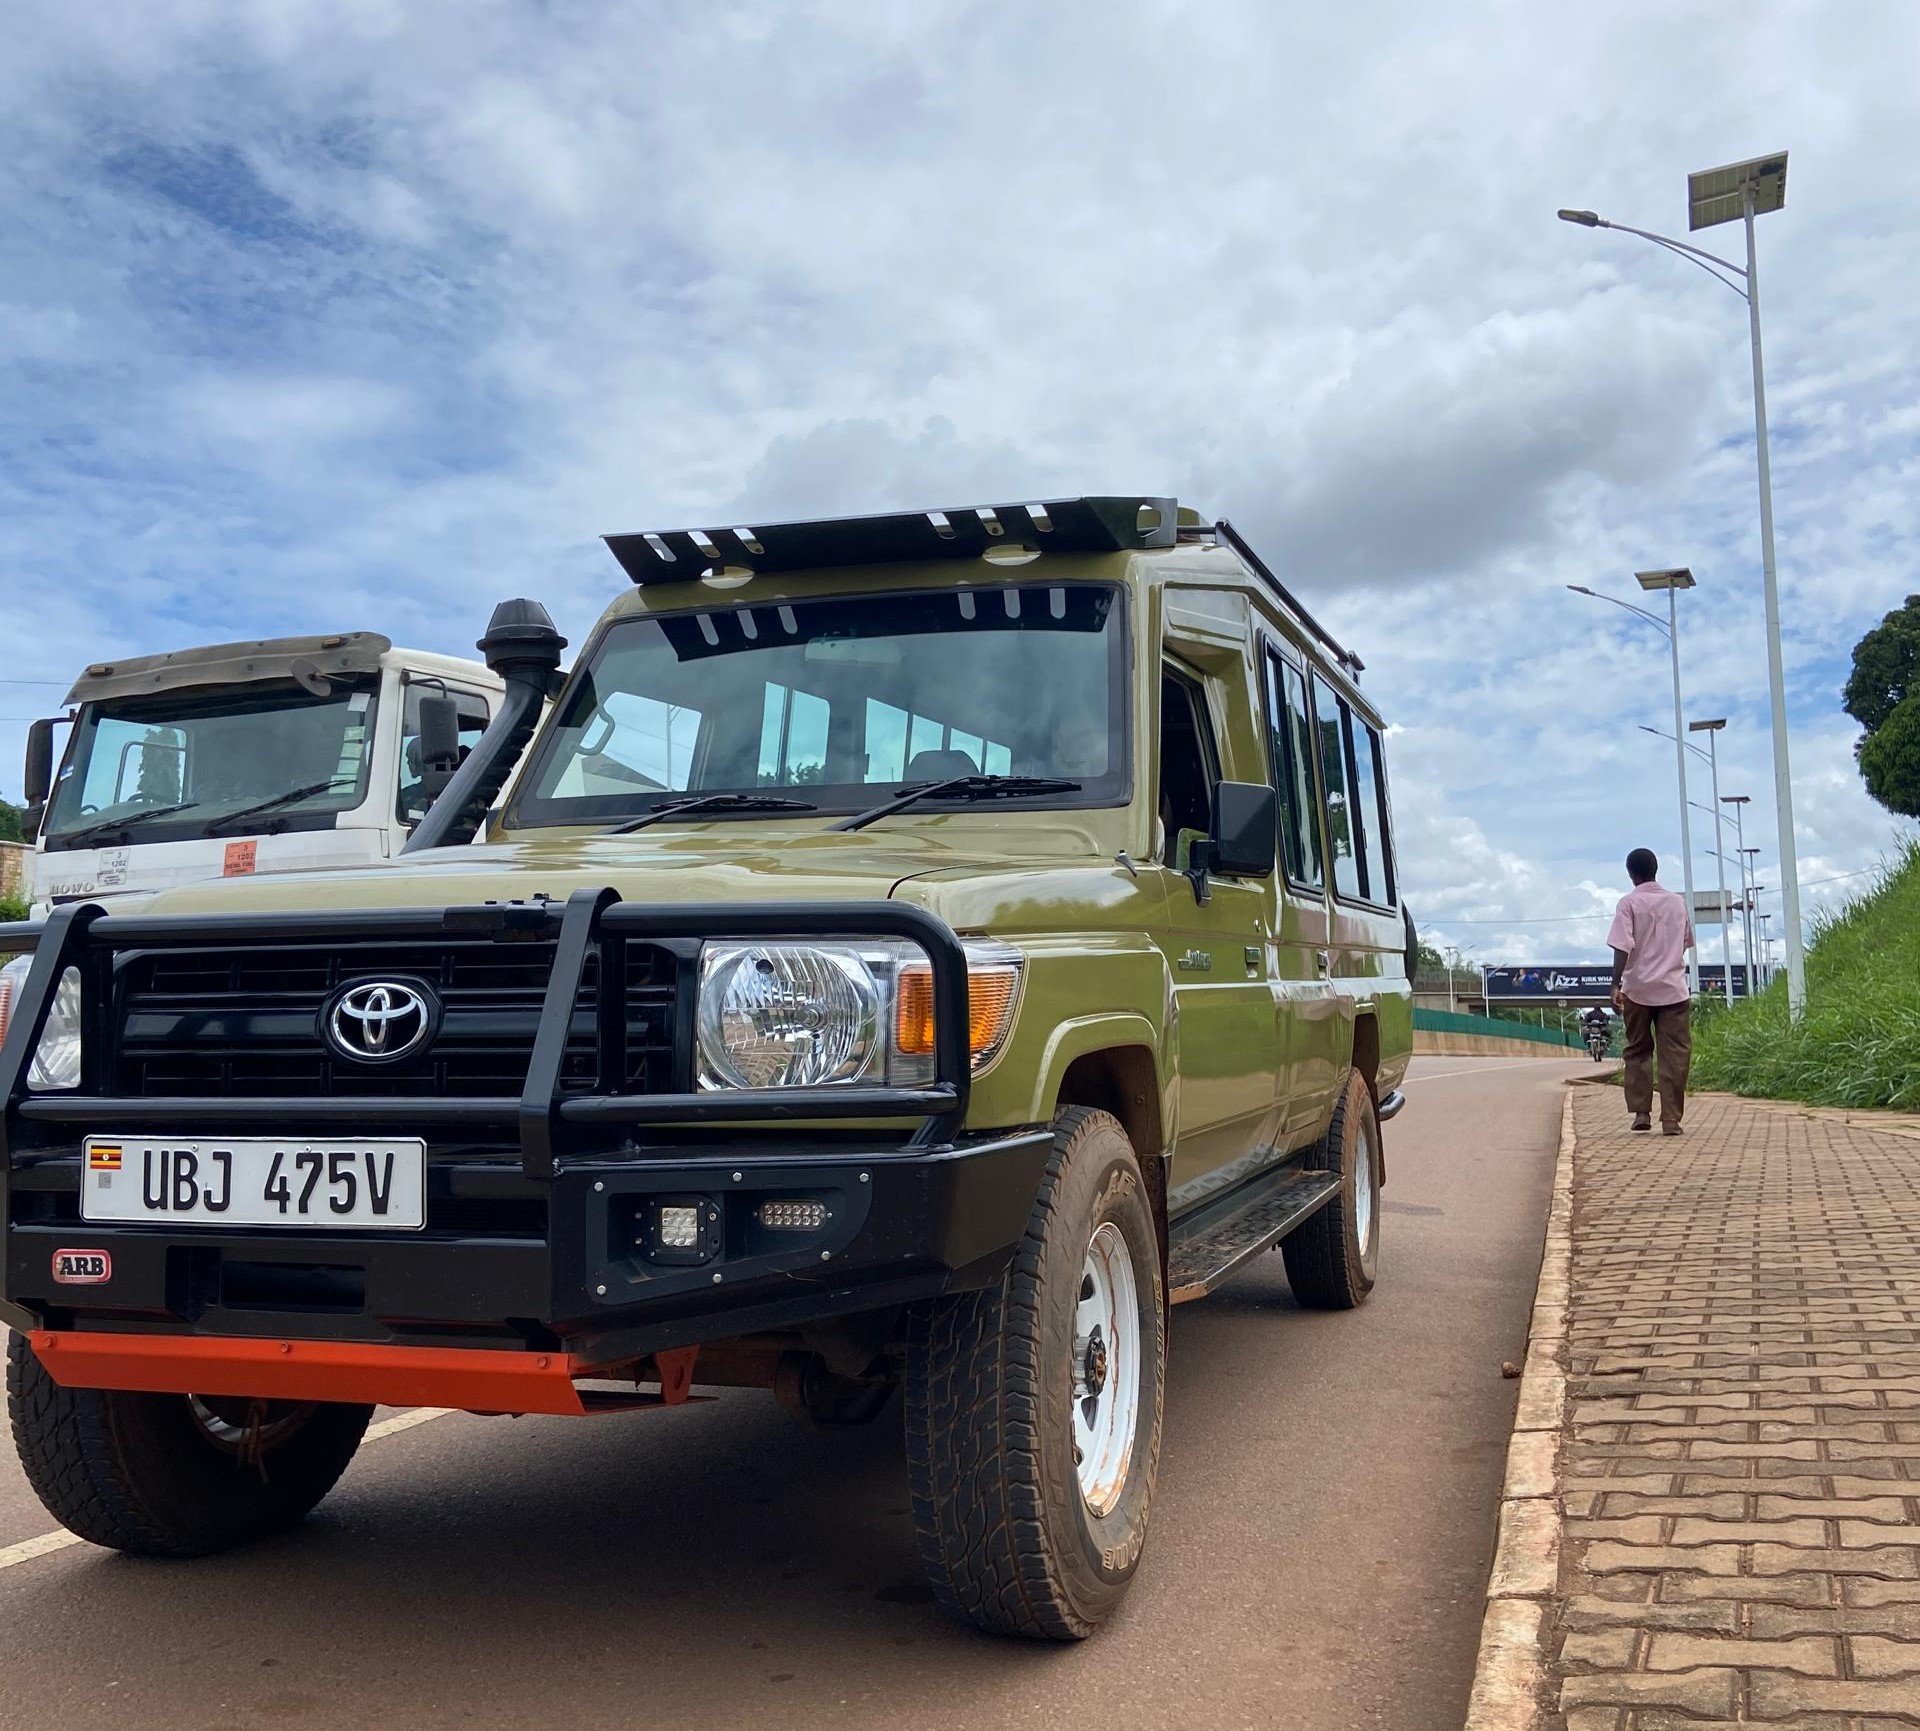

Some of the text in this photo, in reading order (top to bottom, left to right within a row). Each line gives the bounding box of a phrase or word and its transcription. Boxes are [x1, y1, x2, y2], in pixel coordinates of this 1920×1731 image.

[142, 1149, 396, 1215] UBJ 475V
[59, 1256, 105, 1276] ARB
